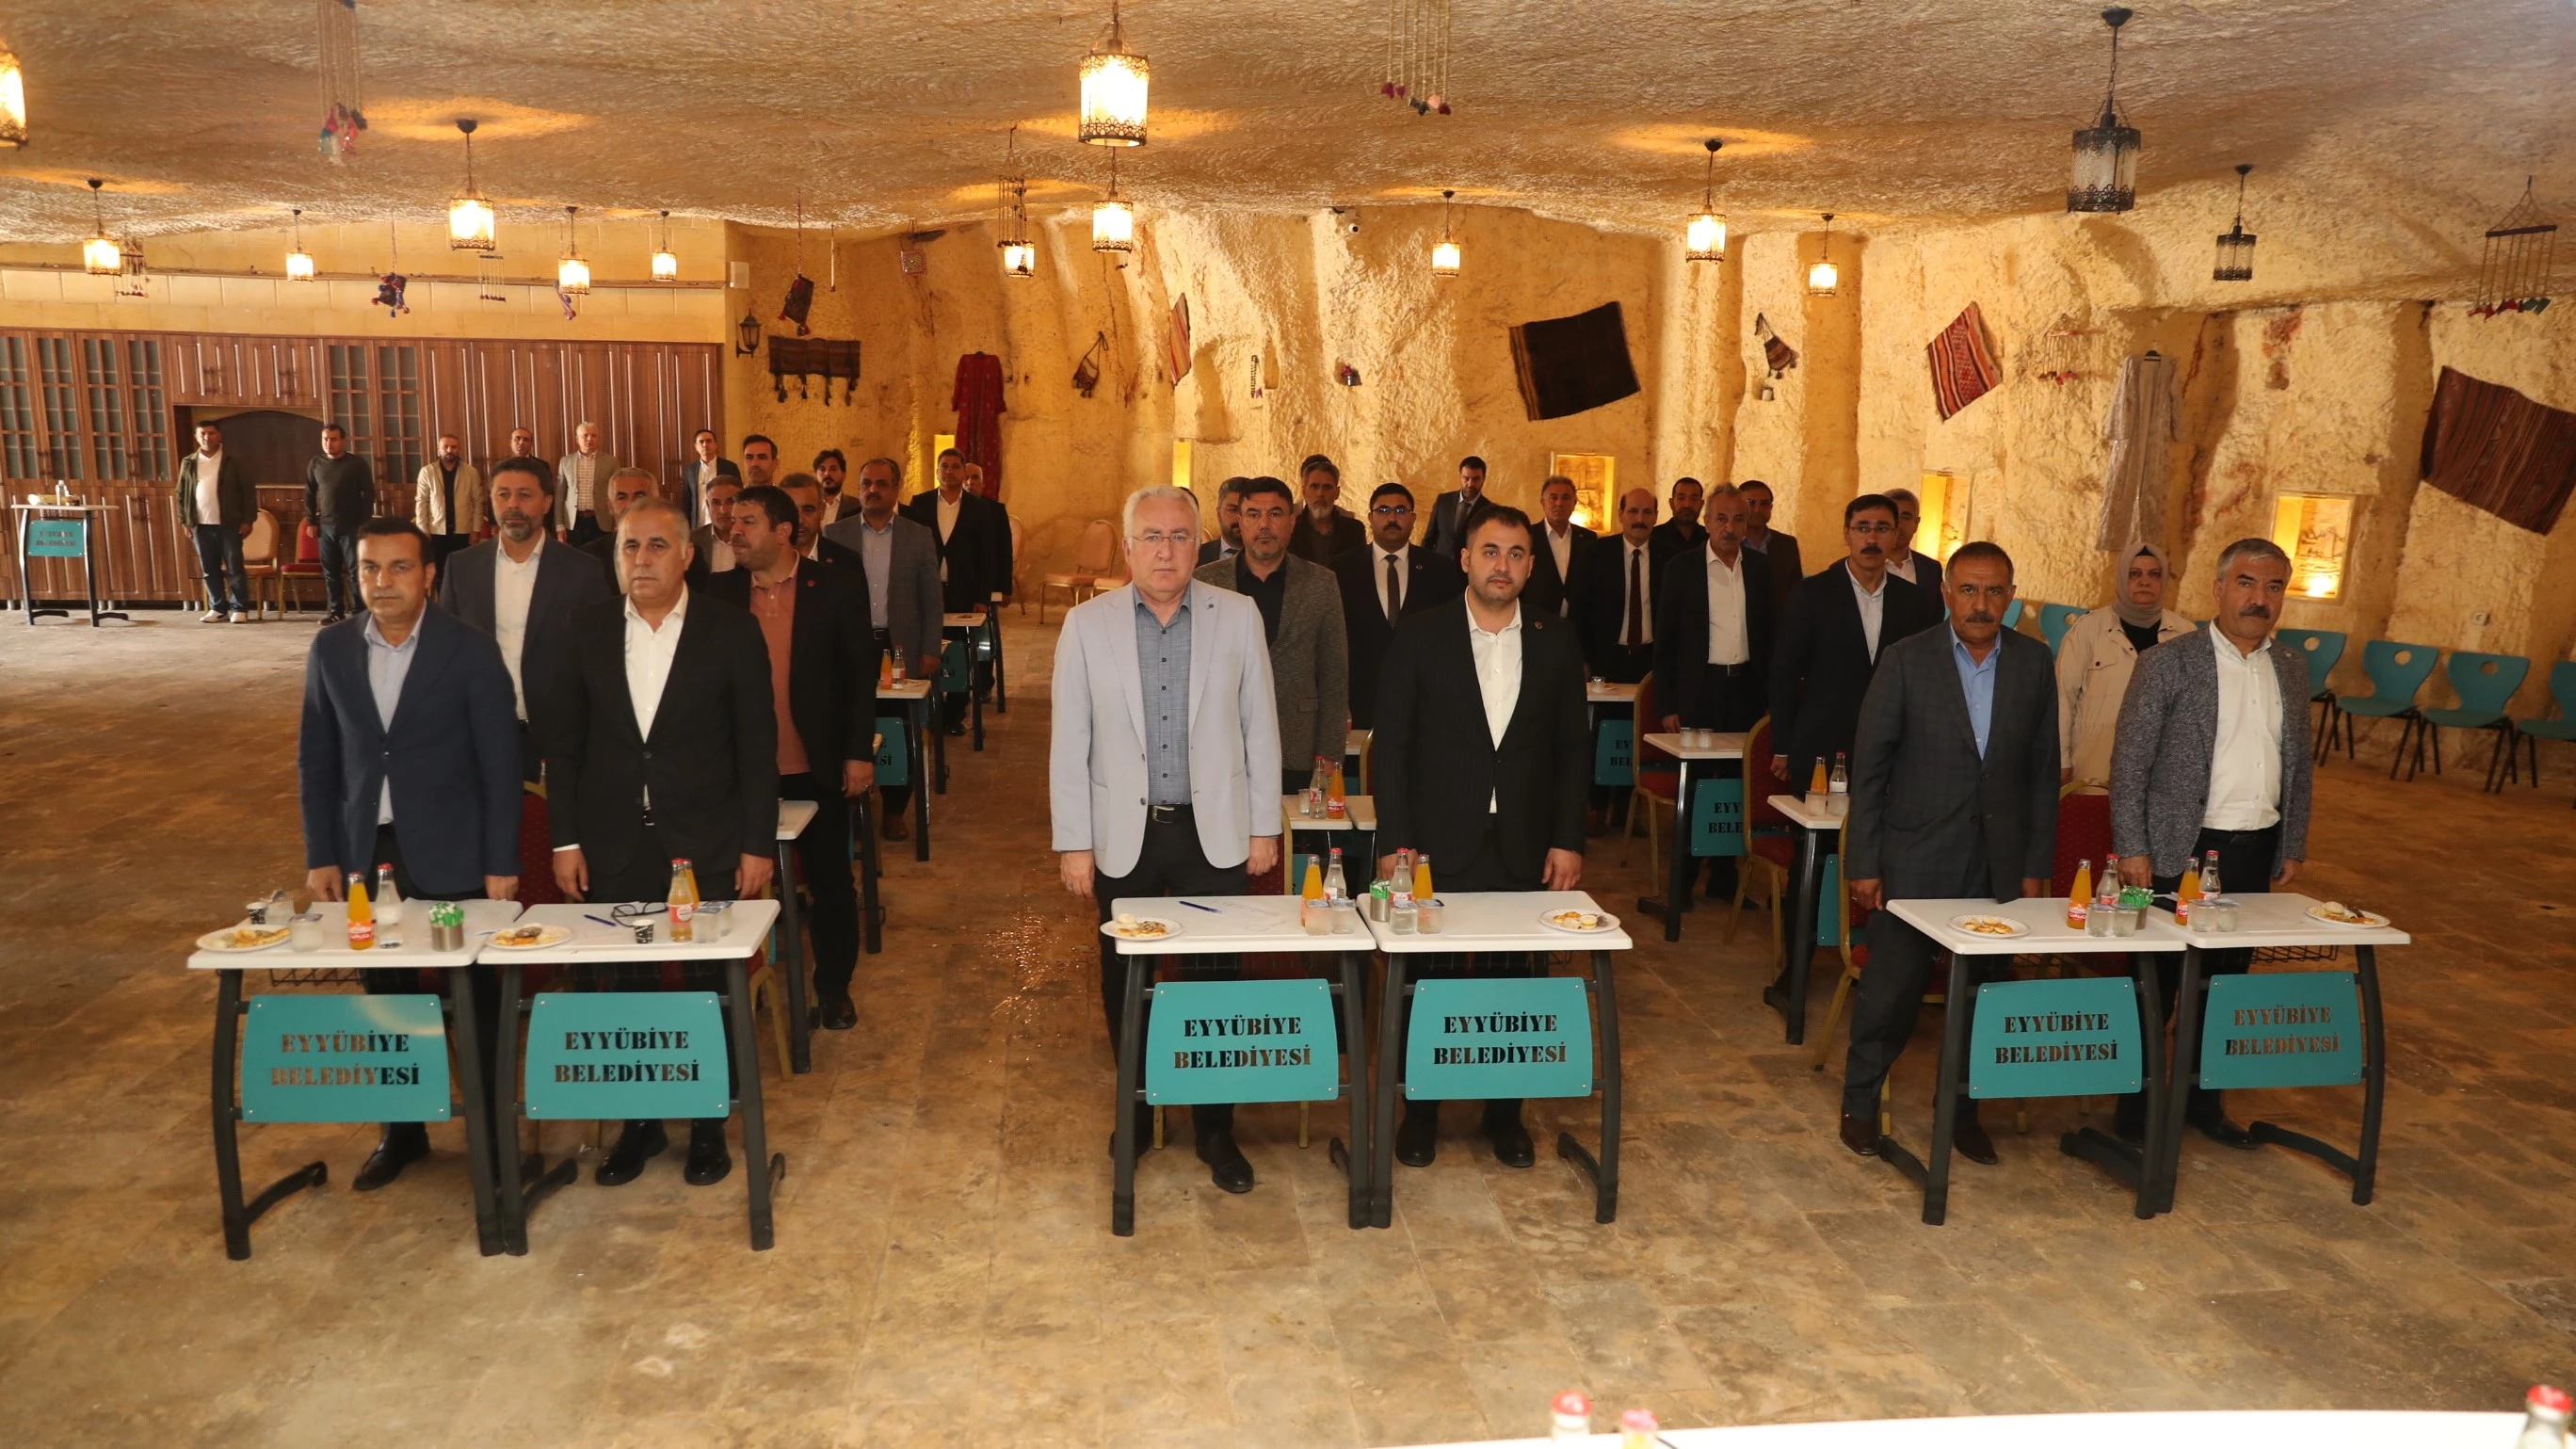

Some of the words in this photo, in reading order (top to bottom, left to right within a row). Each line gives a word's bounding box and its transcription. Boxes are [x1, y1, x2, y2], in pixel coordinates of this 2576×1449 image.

[1183, 1014, 1301, 1037] EYYÜBİYE
[1443, 1011, 1557, 1034] EYYÜBİYE
[2004, 1010, 2109, 1034] EYYÜBİYE
[2234, 1004, 2331, 1025] EYYÜBİYE
[282, 1030, 410, 1053] EYYÜBİYE
[565, 1027, 689, 1050] EYYÜBİYE
[2225, 1032, 2341, 1055] BELEDİYESİ
[1174, 1044, 1312, 1069] BELEDİYESİ
[1433, 1041, 1567, 1065] BELEDİYESİ
[1995, 1039, 2117, 1064] BELEDİYESİ
[271, 1063, 420, 1086] BELEDİYESİ
[555, 1059, 700, 1083] BELEDİYESİ
